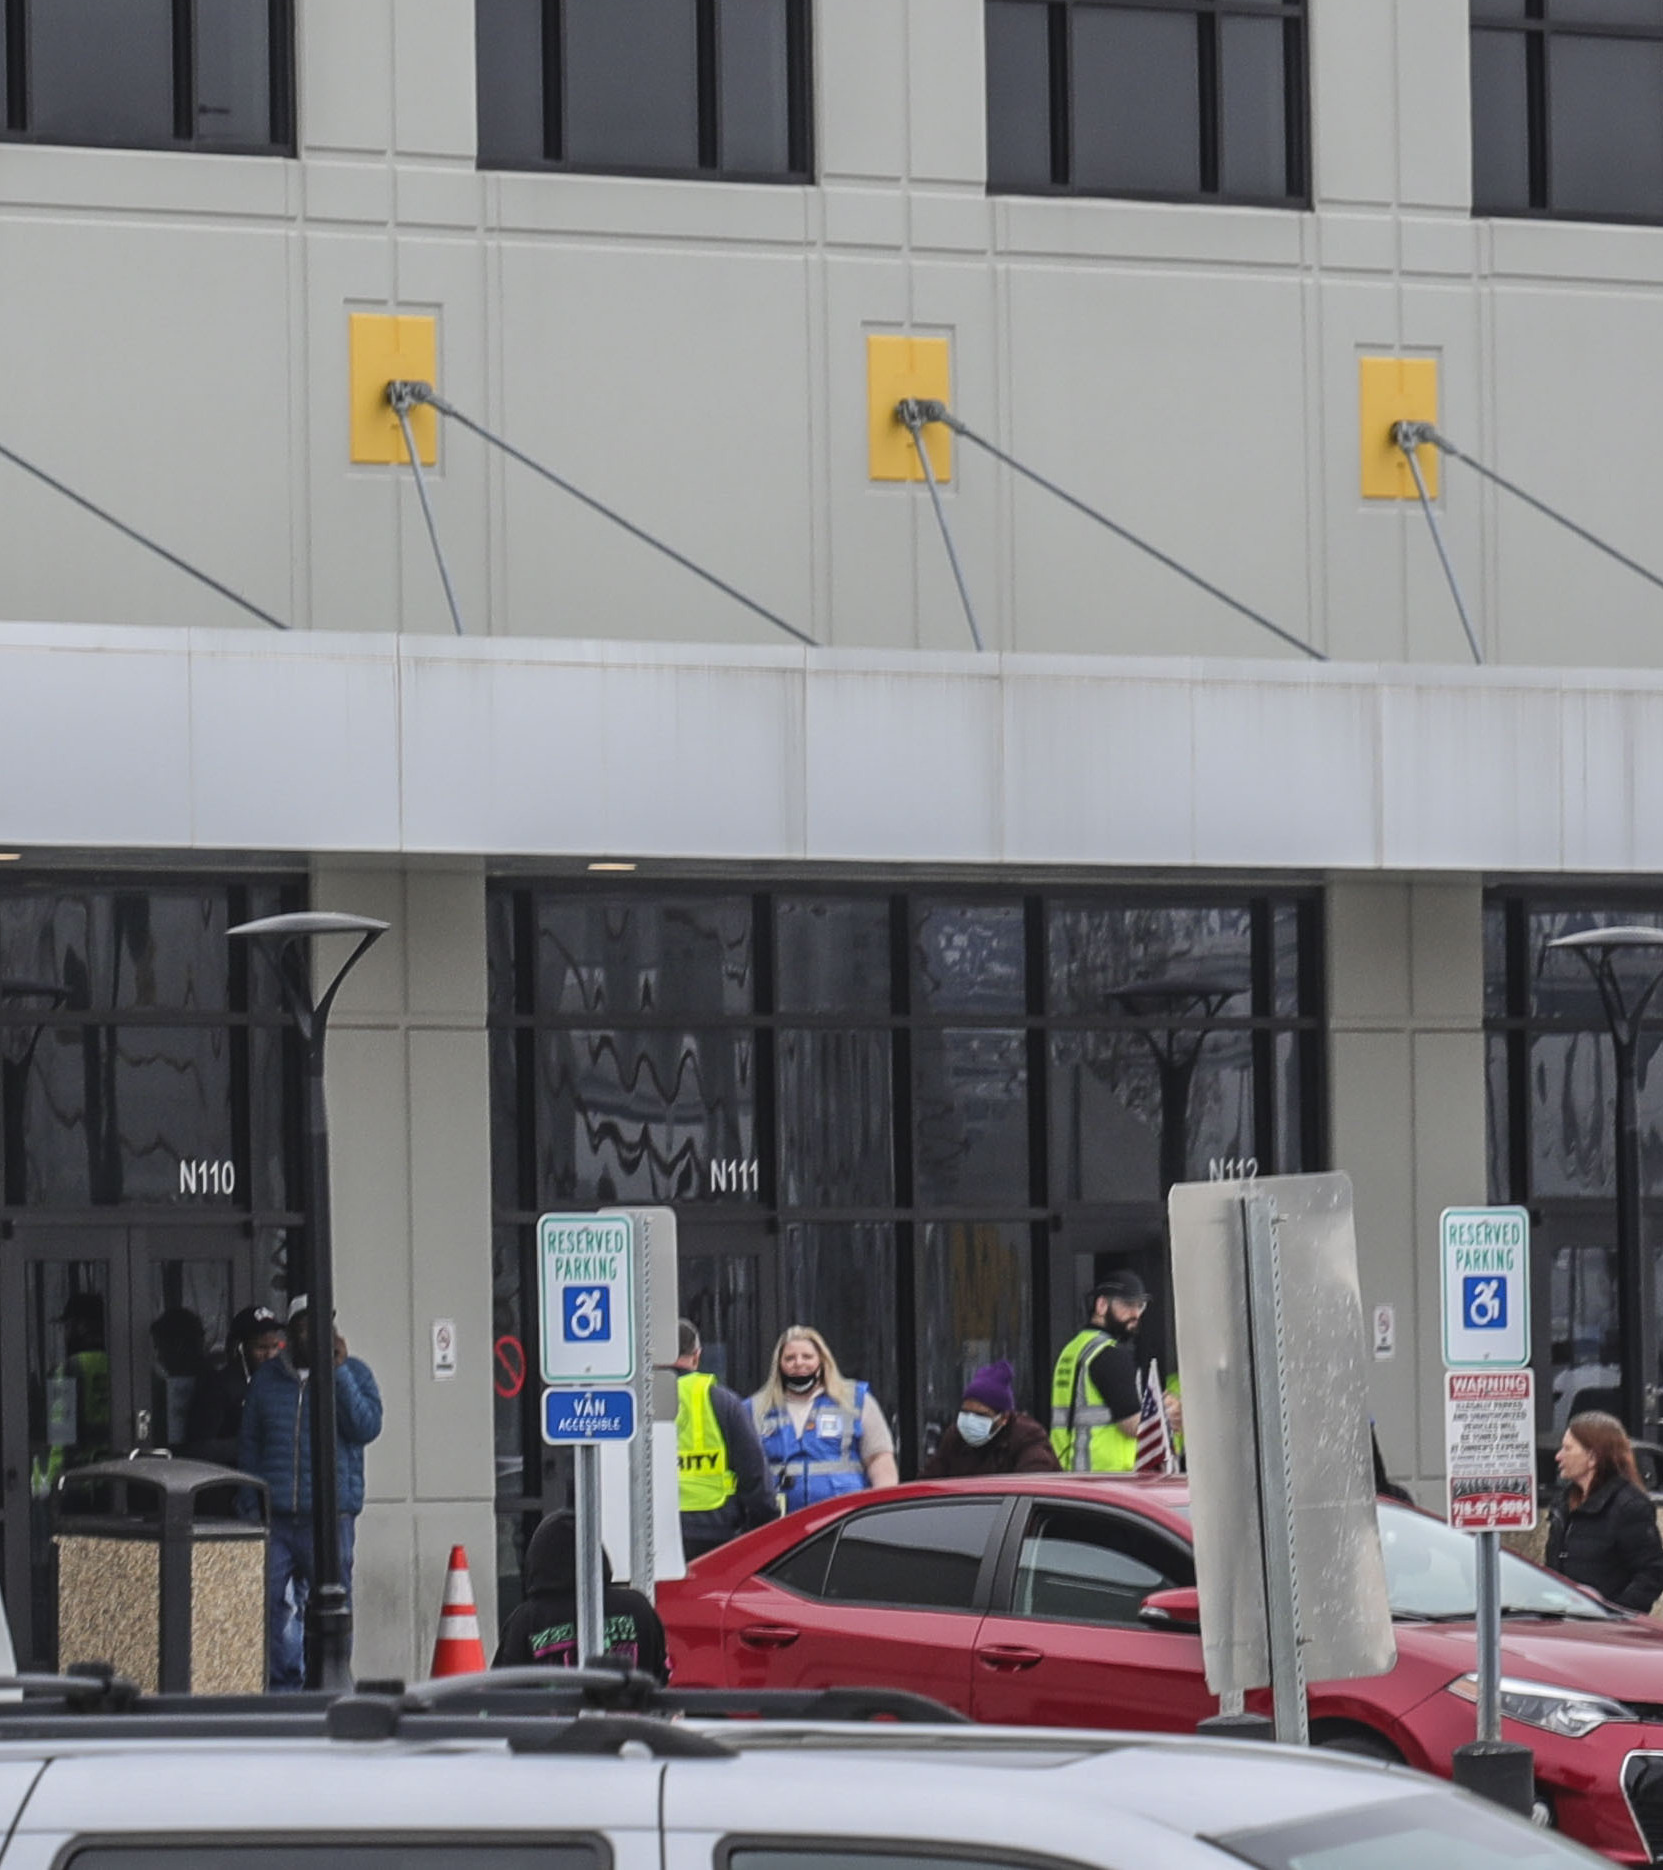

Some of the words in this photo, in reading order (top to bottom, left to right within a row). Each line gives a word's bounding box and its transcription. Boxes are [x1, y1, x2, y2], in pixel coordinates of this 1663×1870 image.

[179, 1159, 235, 1195] N110
[711, 1158, 759, 1193] N111
[547, 1229, 623, 1254] RESERVED
[1449, 1222, 1520, 1245] RESERVED
[554, 1256, 617, 1281] PARKING
[1455, 1248, 1514, 1271] PARKING
[1452, 1375, 1528, 1393] WARNING
[573, 1398, 606, 1416] VAN
[557, 1417, 622, 1432] ACCESSIBLE
